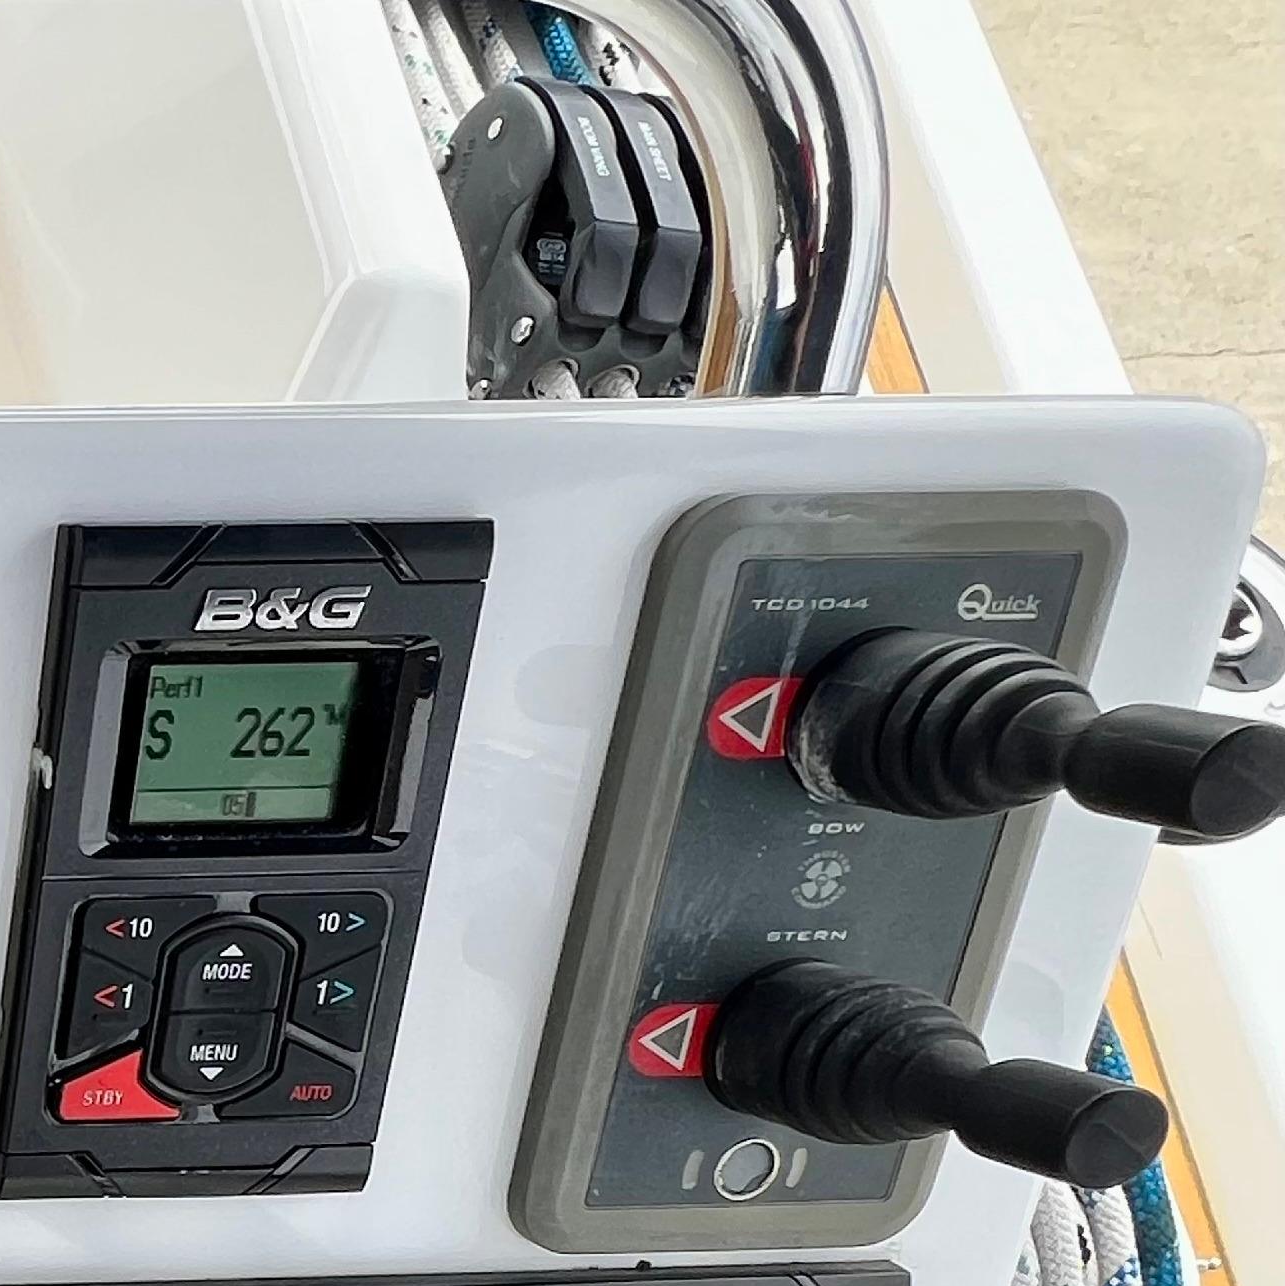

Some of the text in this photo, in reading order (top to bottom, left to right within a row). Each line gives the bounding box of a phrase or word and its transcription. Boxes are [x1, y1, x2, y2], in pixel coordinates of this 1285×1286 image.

[194, 585, 372, 631] B&G
[957, 583, 1041, 621] Quick
[145, 709, 175, 760] S
[230, 706, 316, 759] 262
[808, 822, 866, 834] BOW
[767, 929, 848, 941] STERN
[202, 963, 252, 981] MODE
[189, 1044, 238, 1062] MENU
[82, 1089, 124, 1107] STBY
[290, 1084, 333, 1102] AUTO
